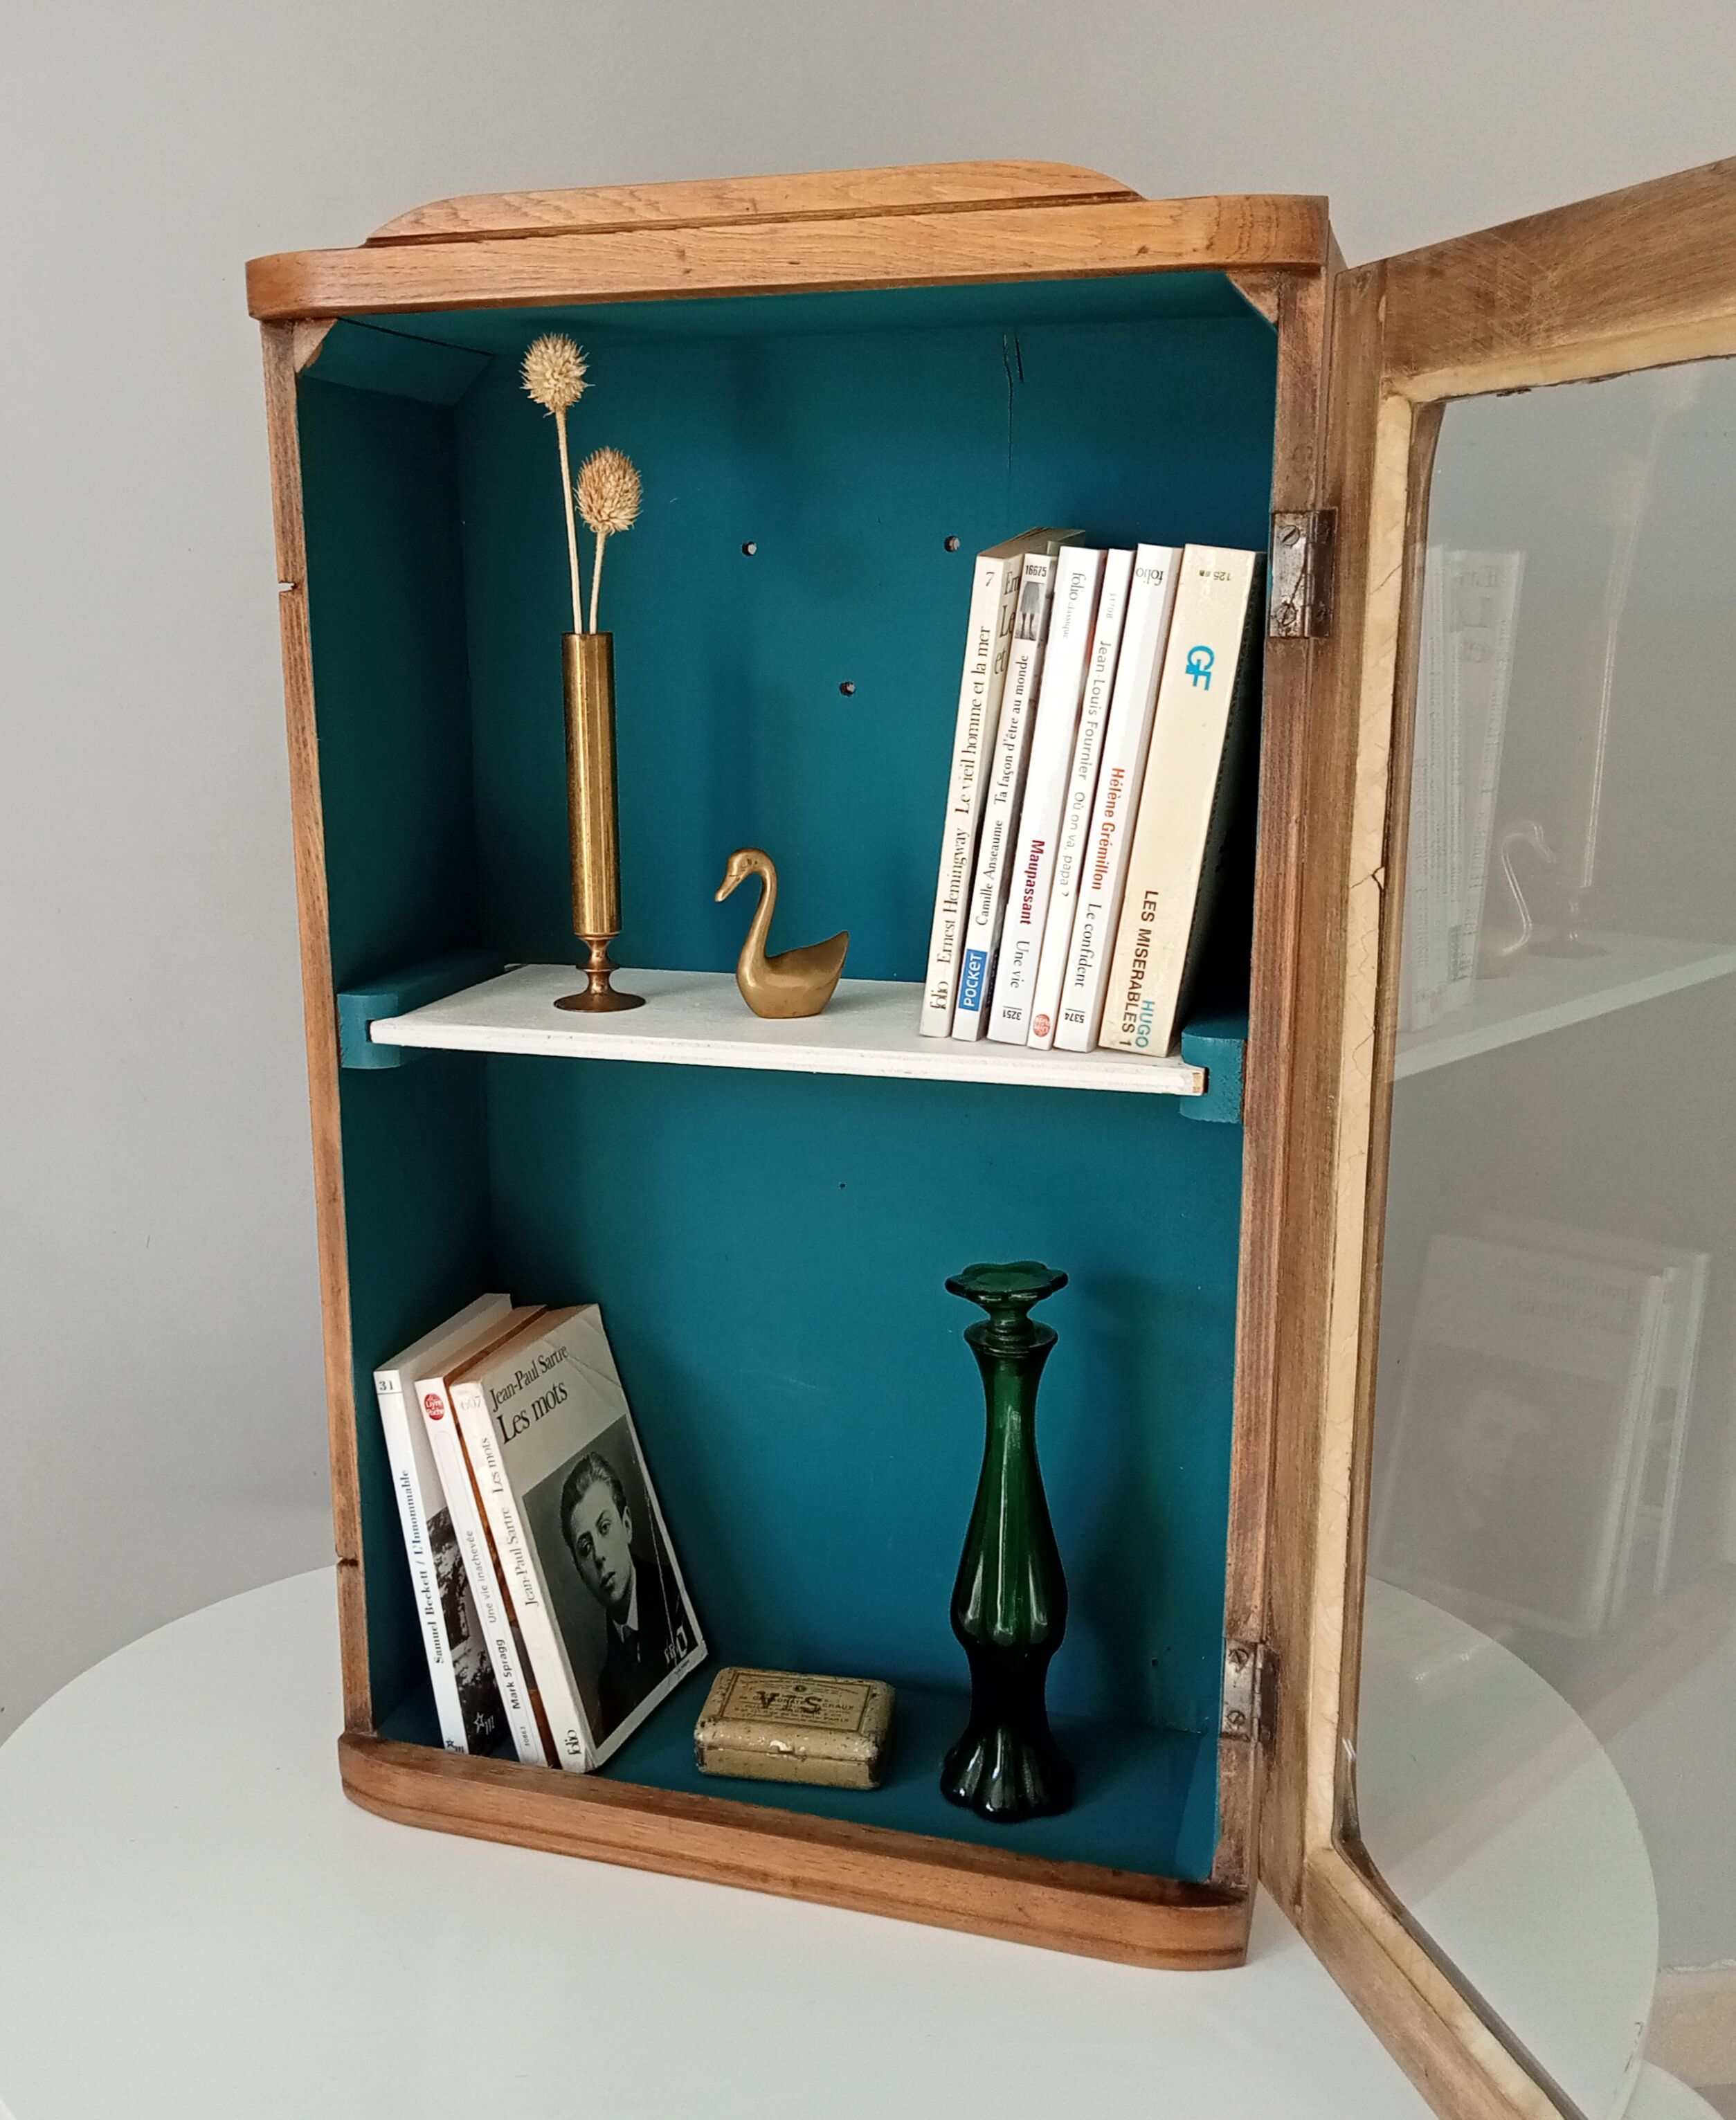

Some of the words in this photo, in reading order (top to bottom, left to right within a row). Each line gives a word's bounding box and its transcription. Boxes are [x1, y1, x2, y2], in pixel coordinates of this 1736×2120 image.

[985, 572, 995, 587] 7
[1025, 565, 1047, 577] 16675
[1069, 572, 1087, 601] folio
[1136, 568, 1164, 586] folio
[1063, 601, 1074, 639] classique
[977, 626, 991, 658] mer
[971, 662, 986, 676] la
[1015, 655, 1029, 696] monde
[1088, 640, 1112, 716] Jean-Louis
[1185, 645, 1215, 691] GF
[974, 682, 984, 694] et
[1012, 699, 1022, 714] au
[961, 698, 983, 754] homme
[1002, 717, 1019, 752] d'être
[1078, 721, 1098, 780] Fournier
[958, 759, 975, 792] vieil
[997, 755, 1014, 787] façon
[955, 794, 970, 814] Le
[993, 794, 1009, 806] Ta
[1072, 792, 1085, 810] Où
[1104, 768, 1125, 818] Hélène
[1069, 815, 1080, 831] on
[983, 820, 1003, 880] Anseaume
[1064, 835, 1077, 850] va,
[1092, 822, 1115, 890] Grémillon
[943, 828, 970, 914] Hemingway
[1020, 840, 1045, 925] Maupassant
[1060, 855, 1073, 886] papa
[975, 883, 993, 925] Camille
[1085, 903, 1102, 920] Le
[1140, 890, 1159, 923] LES
[937, 920, 956, 963] Ernest
[1013, 940, 1030, 969] Une
[1074, 923, 1096, 988] confident
[1010, 970, 1025, 988] vie
[1121, 928, 1150, 1033] MISERABLES
[929, 981, 949, 1010] folio
[1003, 1010, 1022, 1021] 3251
[1065, 1011, 1085, 1024] 5374
[1135, 999, 1155, 1048] HUGO
[379, 1380, 394, 1391] 31
[489, 1360, 539, 1413] Jean-Paul
[537, 1346, 570, 1373] Sartre
[460, 1395, 482, 1411] 607
[496, 1409, 530, 1446] Les
[531, 1381, 568, 1422] mots
[482, 1438, 497, 1468] mots
[490, 1471, 504, 1494] Les
[399, 1470, 424, 1555] L'Innommable
[502, 1507, 519, 1546] Sartre
[466, 1530, 486, 1582] inachevée
[418, 1570, 435, 1616] Beckett
[480, 1585, 491, 1599] vie
[510, 1548, 539, 1606] Jean-Paul
[486, 1602, 497, 1623] Une
[428, 1622, 444, 1664] Samuel
[496, 1639, 512, 1678] Spragg
[506, 1682, 521, 1710] Mark
[564, 1730, 582, 1755] folio
